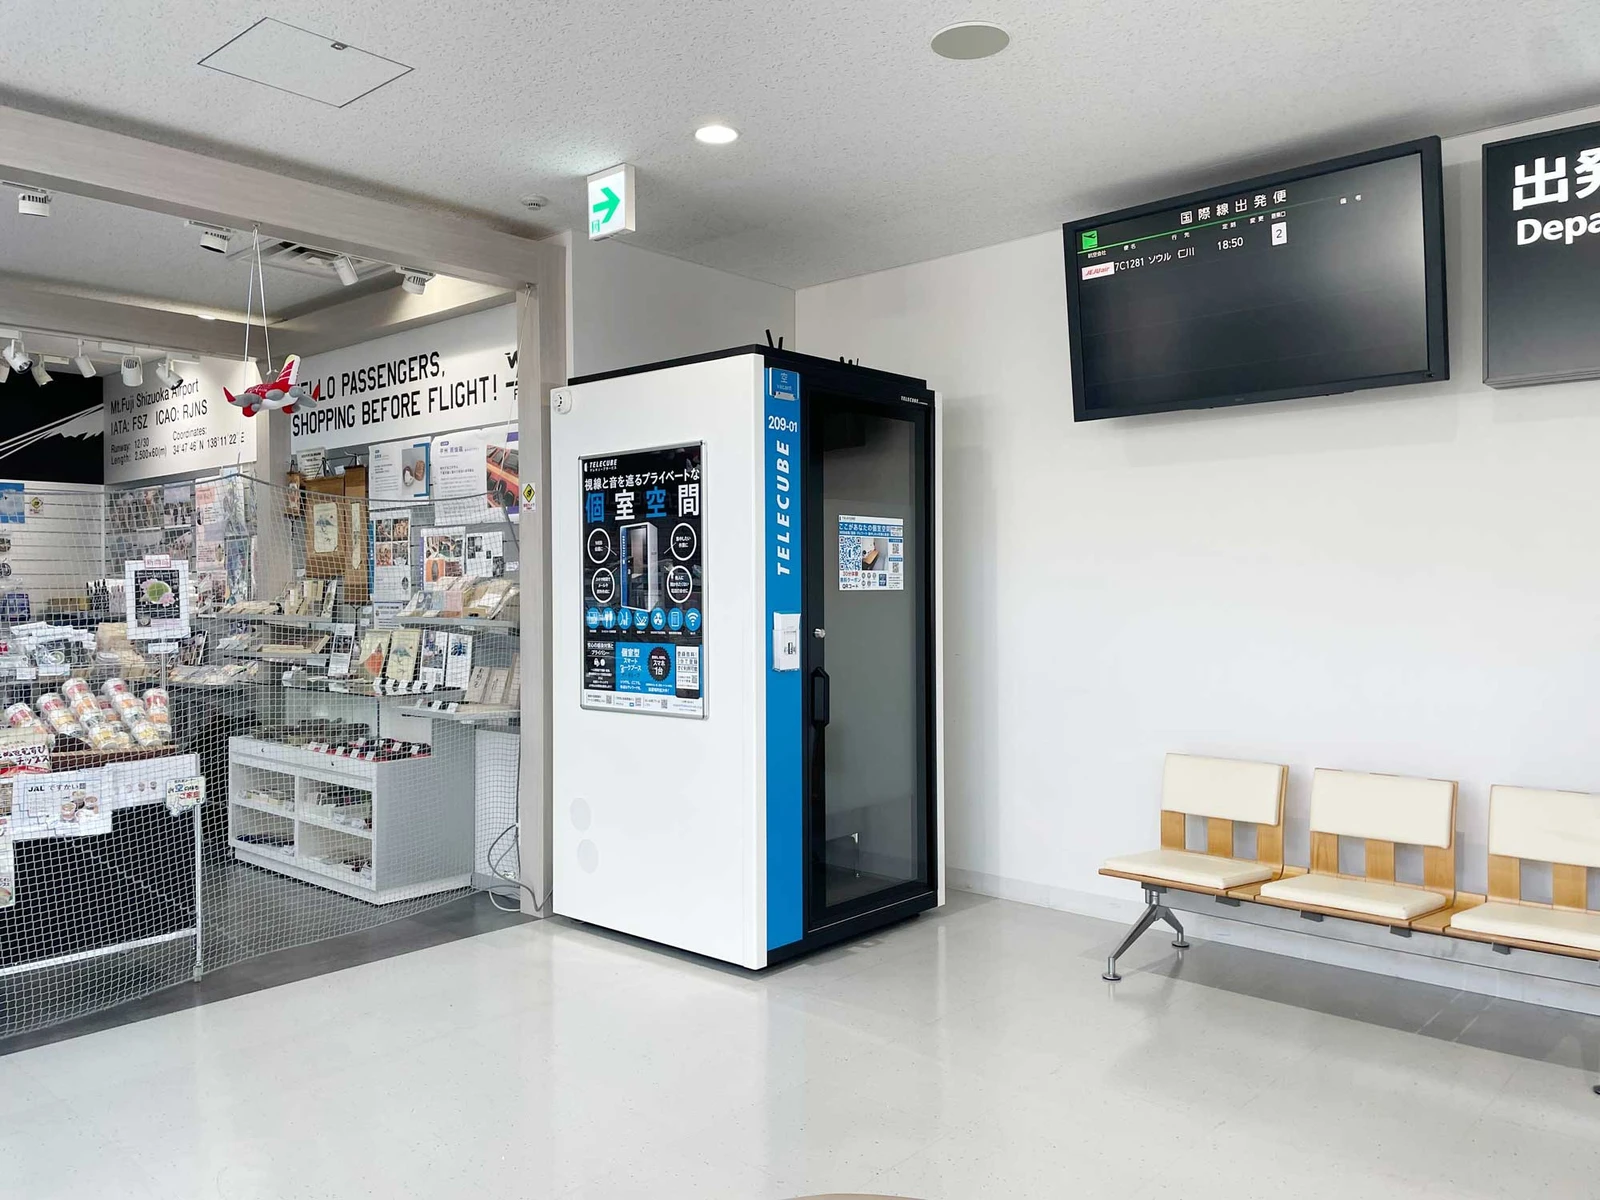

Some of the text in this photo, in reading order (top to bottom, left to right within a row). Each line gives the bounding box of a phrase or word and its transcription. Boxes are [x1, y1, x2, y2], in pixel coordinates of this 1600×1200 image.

[1180, 189, 1287, 225] 国際線出発便
[1114, 229, 1283, 272] 7C1281 ソウル 仁川 18:50 2
[297, 351, 446, 402] LLO PASSENGERS,
[136, 388, 170, 410] Shizuoka
[292, 404, 356, 437] SHOPPING
[361, 390, 421, 426] BEFORE
[428, 374, 498, 413] FLIGHT!
[110, 399, 208, 436] IATA: FSZ ICAO: RJNS
[172, 427, 207, 441] Coordinates:
[768, 415, 798, 433] 209-01
[134, 437, 150, 449] 12/30
[584, 468, 700, 491] 視線と音を遮るプライベートな
[589, 458, 618, 469] TELECUBE
[585, 483, 700, 524] 個室空間
[776, 440, 790, 577] TELECUBE
